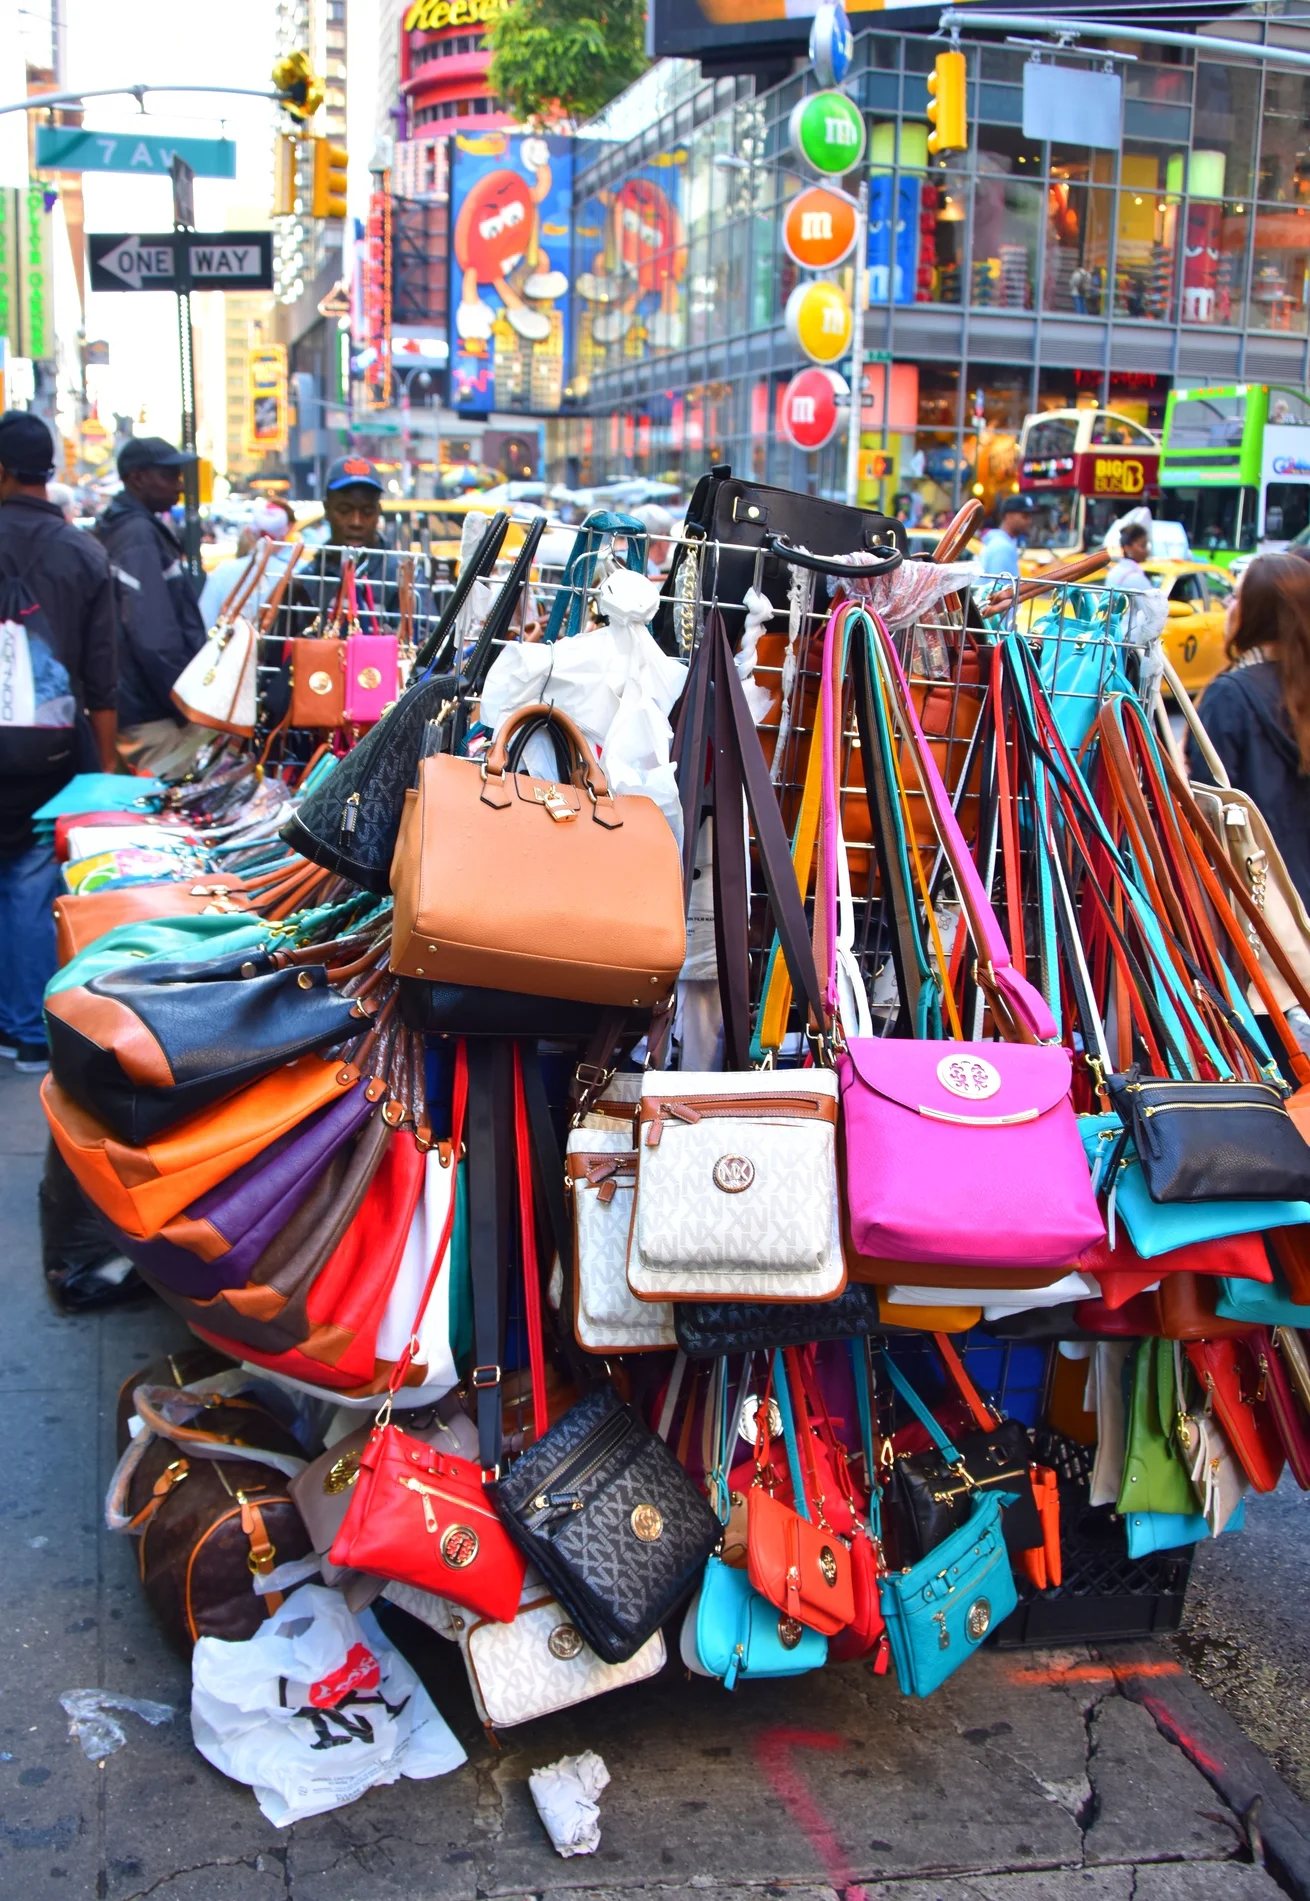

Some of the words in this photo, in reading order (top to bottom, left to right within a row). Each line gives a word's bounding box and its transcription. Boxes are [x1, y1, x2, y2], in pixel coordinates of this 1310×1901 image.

[824, 116, 857, 146] m
[97, 139, 117, 165] 7
[130, 142, 178, 167] Av
[801, 212, 832, 240] m
[118, 251, 169, 274] ONE
[194, 250, 249, 273] WAY
[822, 307, 845, 335] m
[791, 396, 815, 424] m
[1095, 459, 1122, 477] BIG
[1095, 477, 1122, 492] BUS
